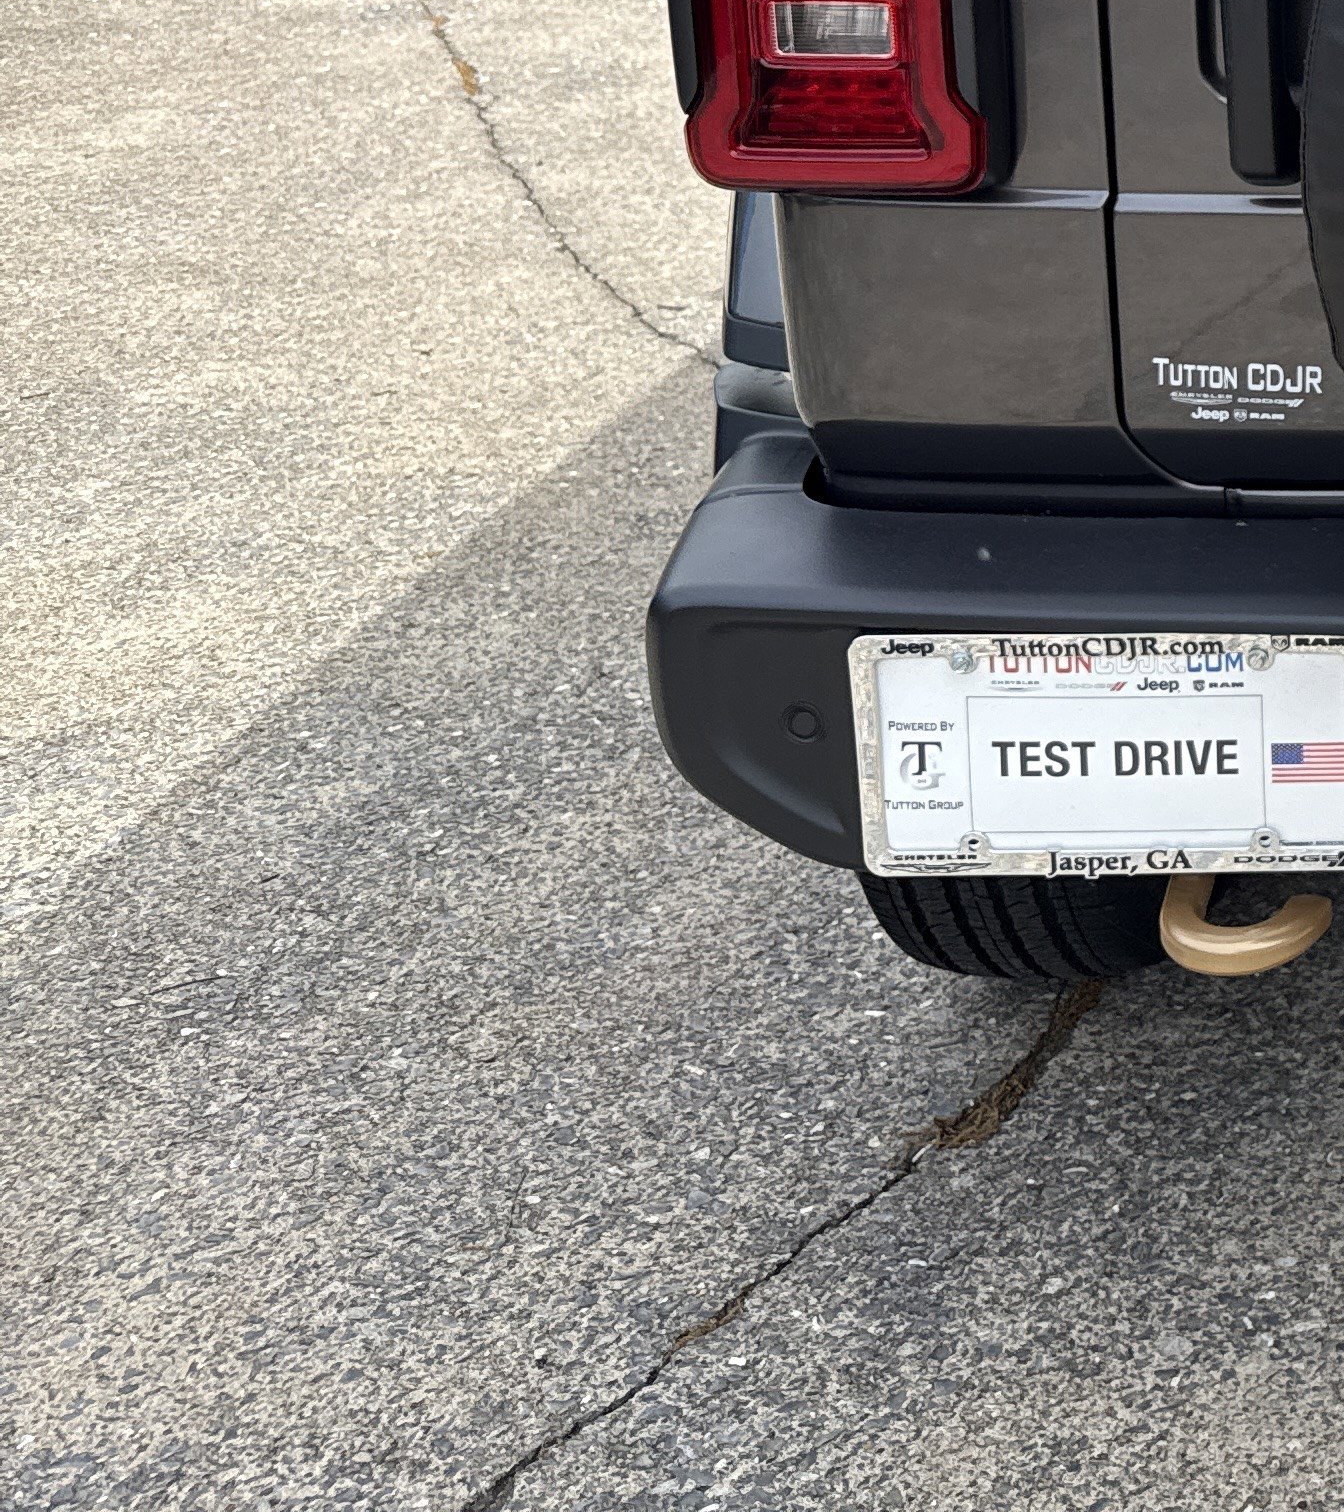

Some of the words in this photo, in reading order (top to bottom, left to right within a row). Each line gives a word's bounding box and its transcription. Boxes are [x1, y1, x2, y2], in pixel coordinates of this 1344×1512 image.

[1247, 363, 1323, 394] CDJR
[1190, 406, 1230, 423] Jeep
[1249, 412, 1285, 420] RAM
[881, 639, 935, 657] Jeep
[992, 637, 1225, 661] TuttonCDJR.com
[1137, 677, 1180, 693] Jeep
[991, 740, 1096, 777] TEST
[1114, 739, 1239, 776] DRIVE
[1047, 850, 1139, 877] Jasper,
[1146, 849, 1193, 869] GA
[1233, 854, 1340, 864] DODGE
